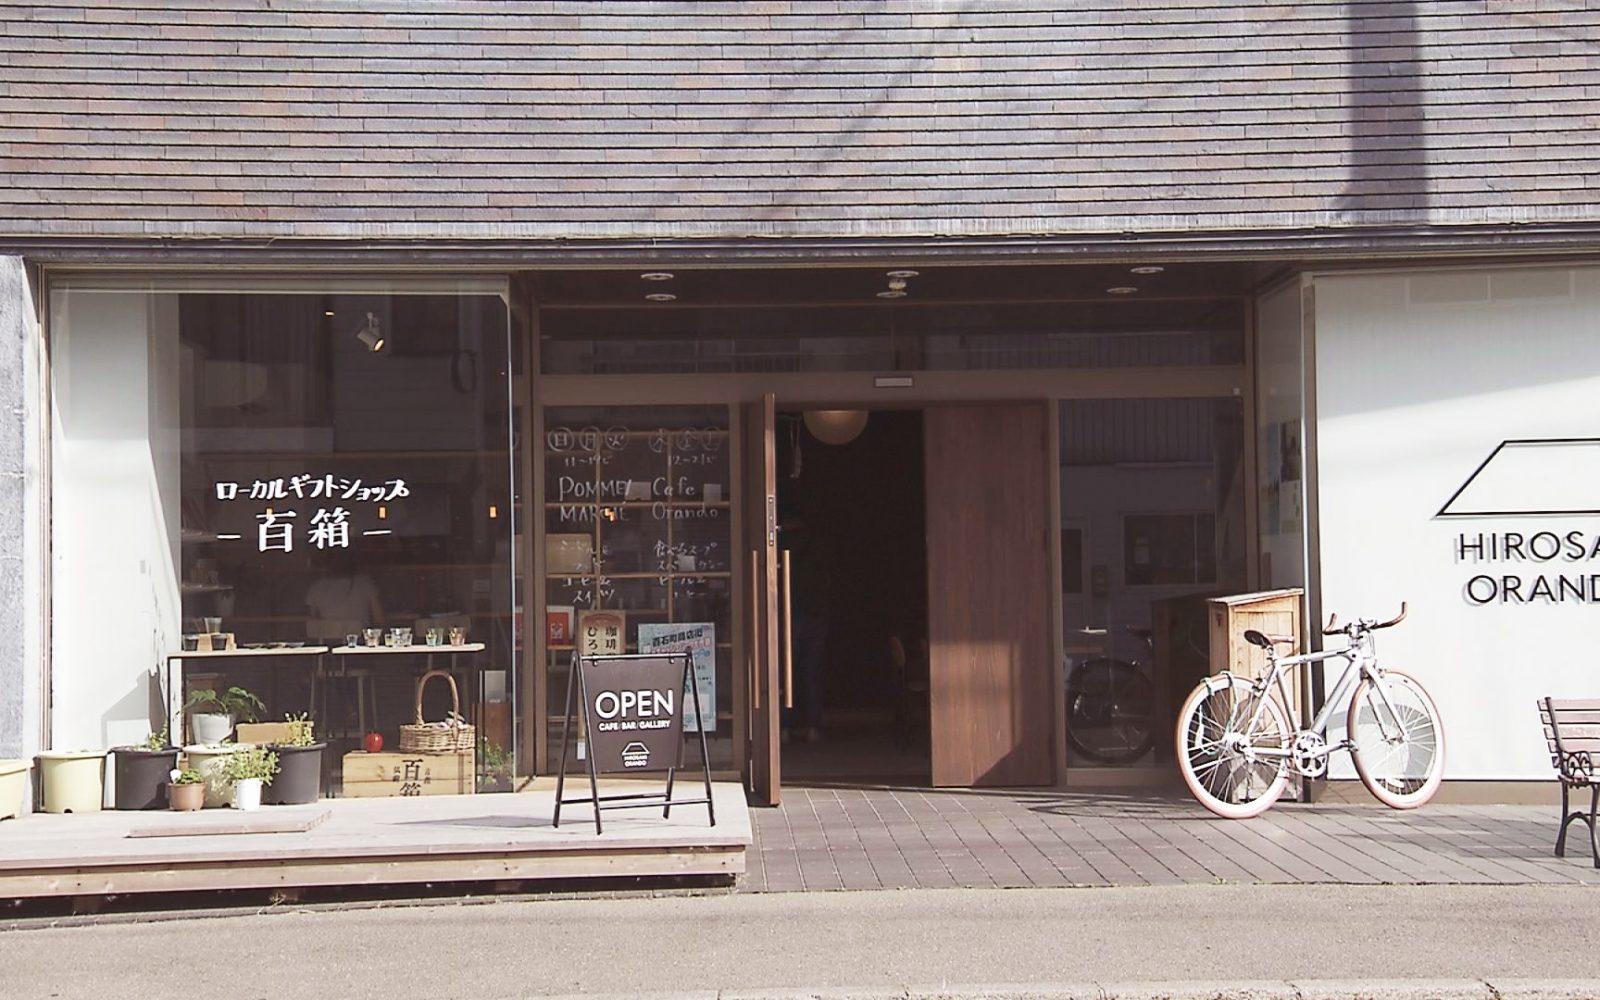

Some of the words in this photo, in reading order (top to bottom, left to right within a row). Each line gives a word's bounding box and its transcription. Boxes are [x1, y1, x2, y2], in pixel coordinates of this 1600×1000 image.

[215, 473, 410, 501] ローカルギフトショップ
[652, 477, 696, 497] Cafe
[255, 506, 350, 553] 百箱
[587, 626, 598, 655] ひろ
[605, 626, 617, 655] 珈琲
[595, 689, 674, 719] OPEN
[639, 720, 671, 730] GALLERY
